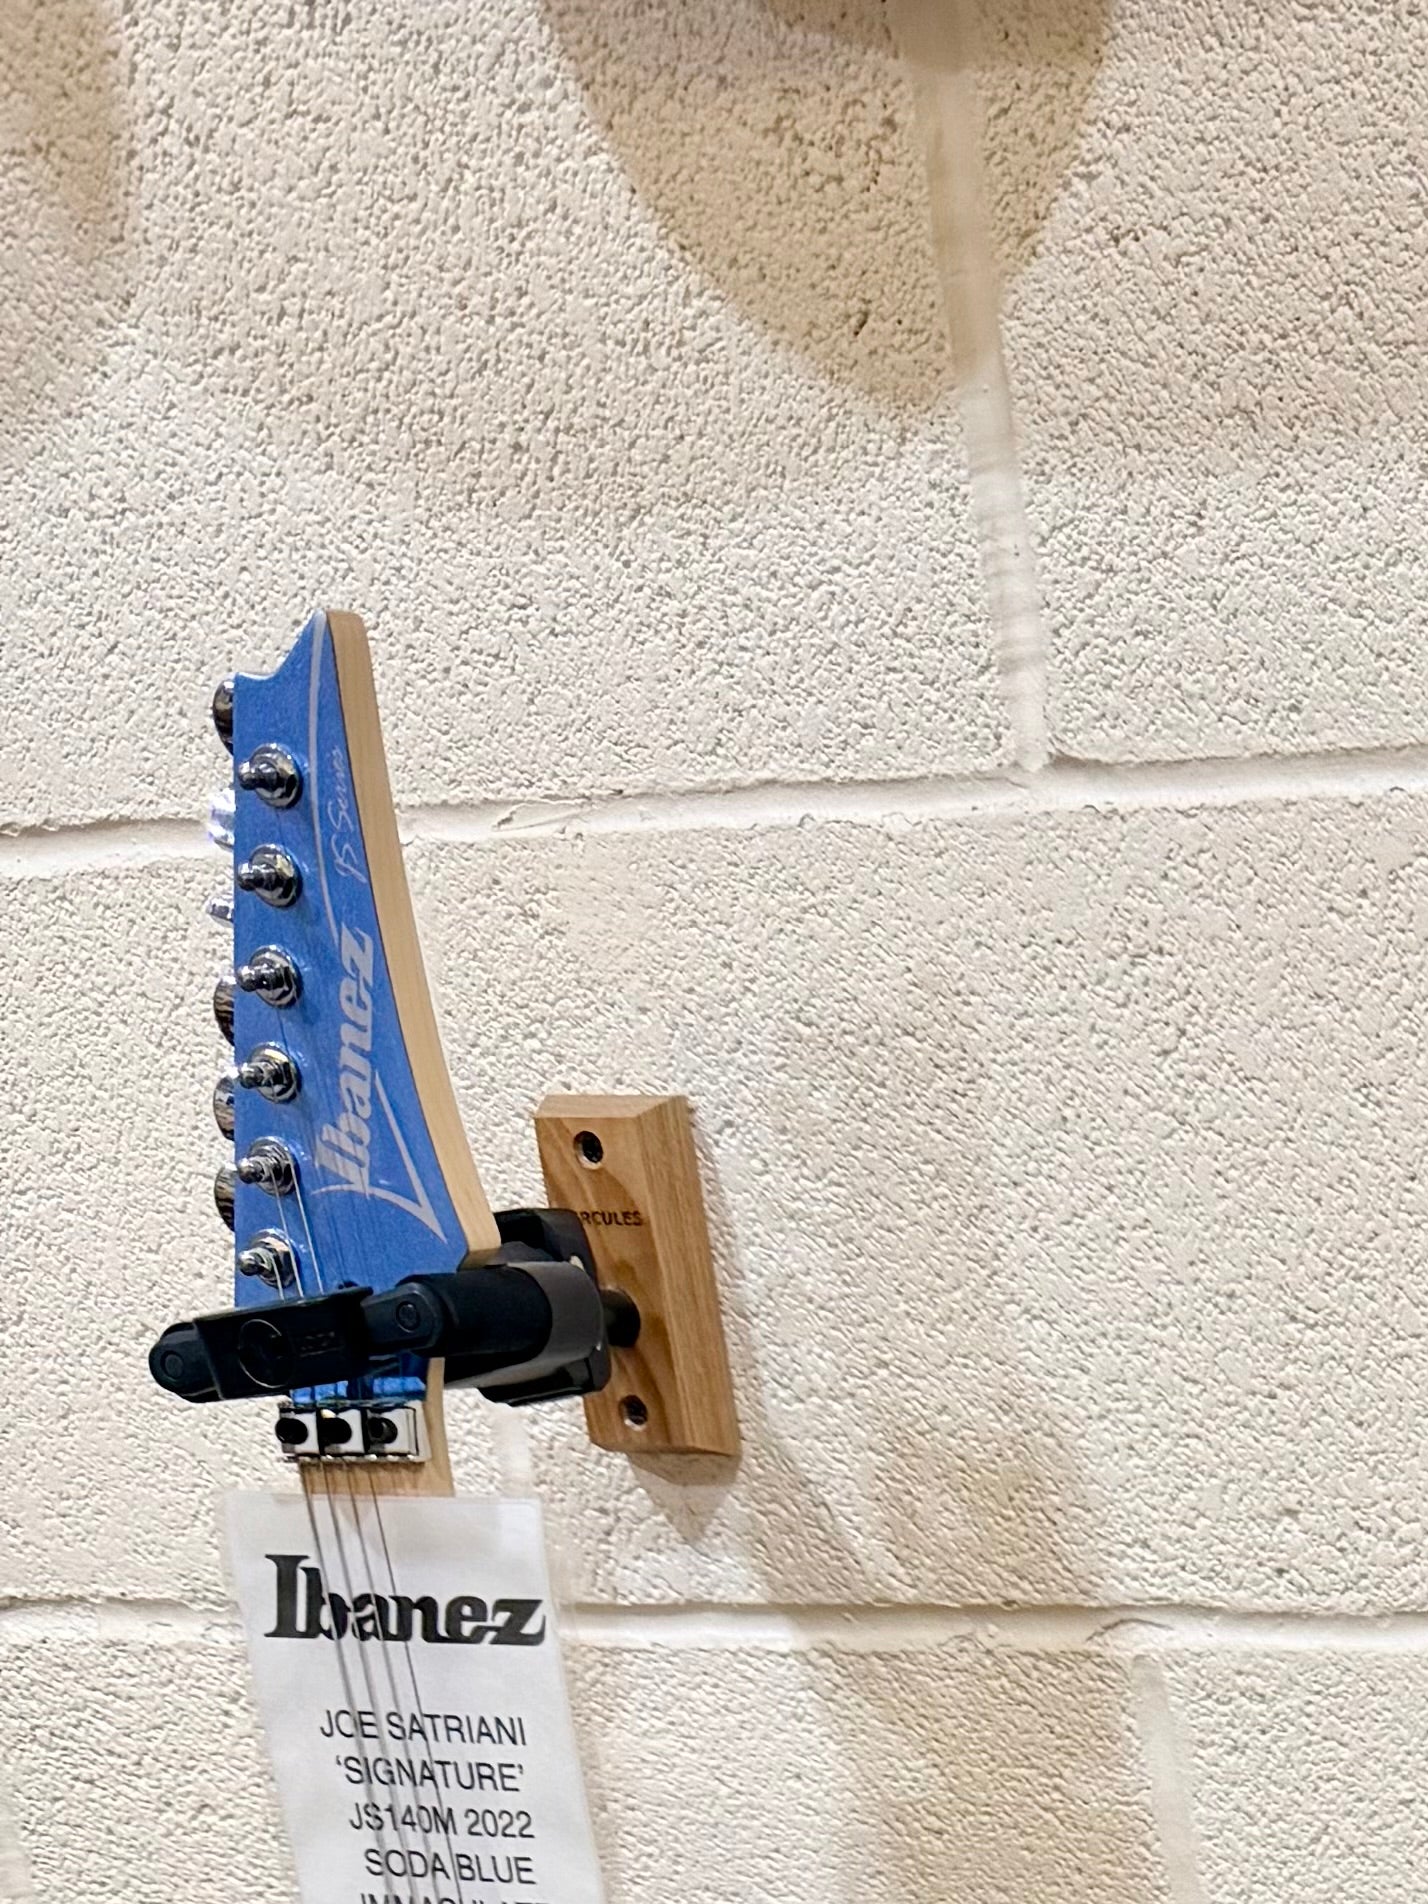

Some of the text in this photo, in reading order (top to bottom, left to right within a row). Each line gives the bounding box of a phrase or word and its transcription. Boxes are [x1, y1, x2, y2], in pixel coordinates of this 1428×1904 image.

[314, 926, 375, 1197] Ibanez
[579, 1211, 643, 1226] RCULES
[264, 1554, 547, 1645] Ibanez
[320, 1710, 526, 1746] JOE SATRIANI
[349, 1806, 535, 1839] JS140M 2022
[366, 1850, 536, 1884] SODA BLUE
